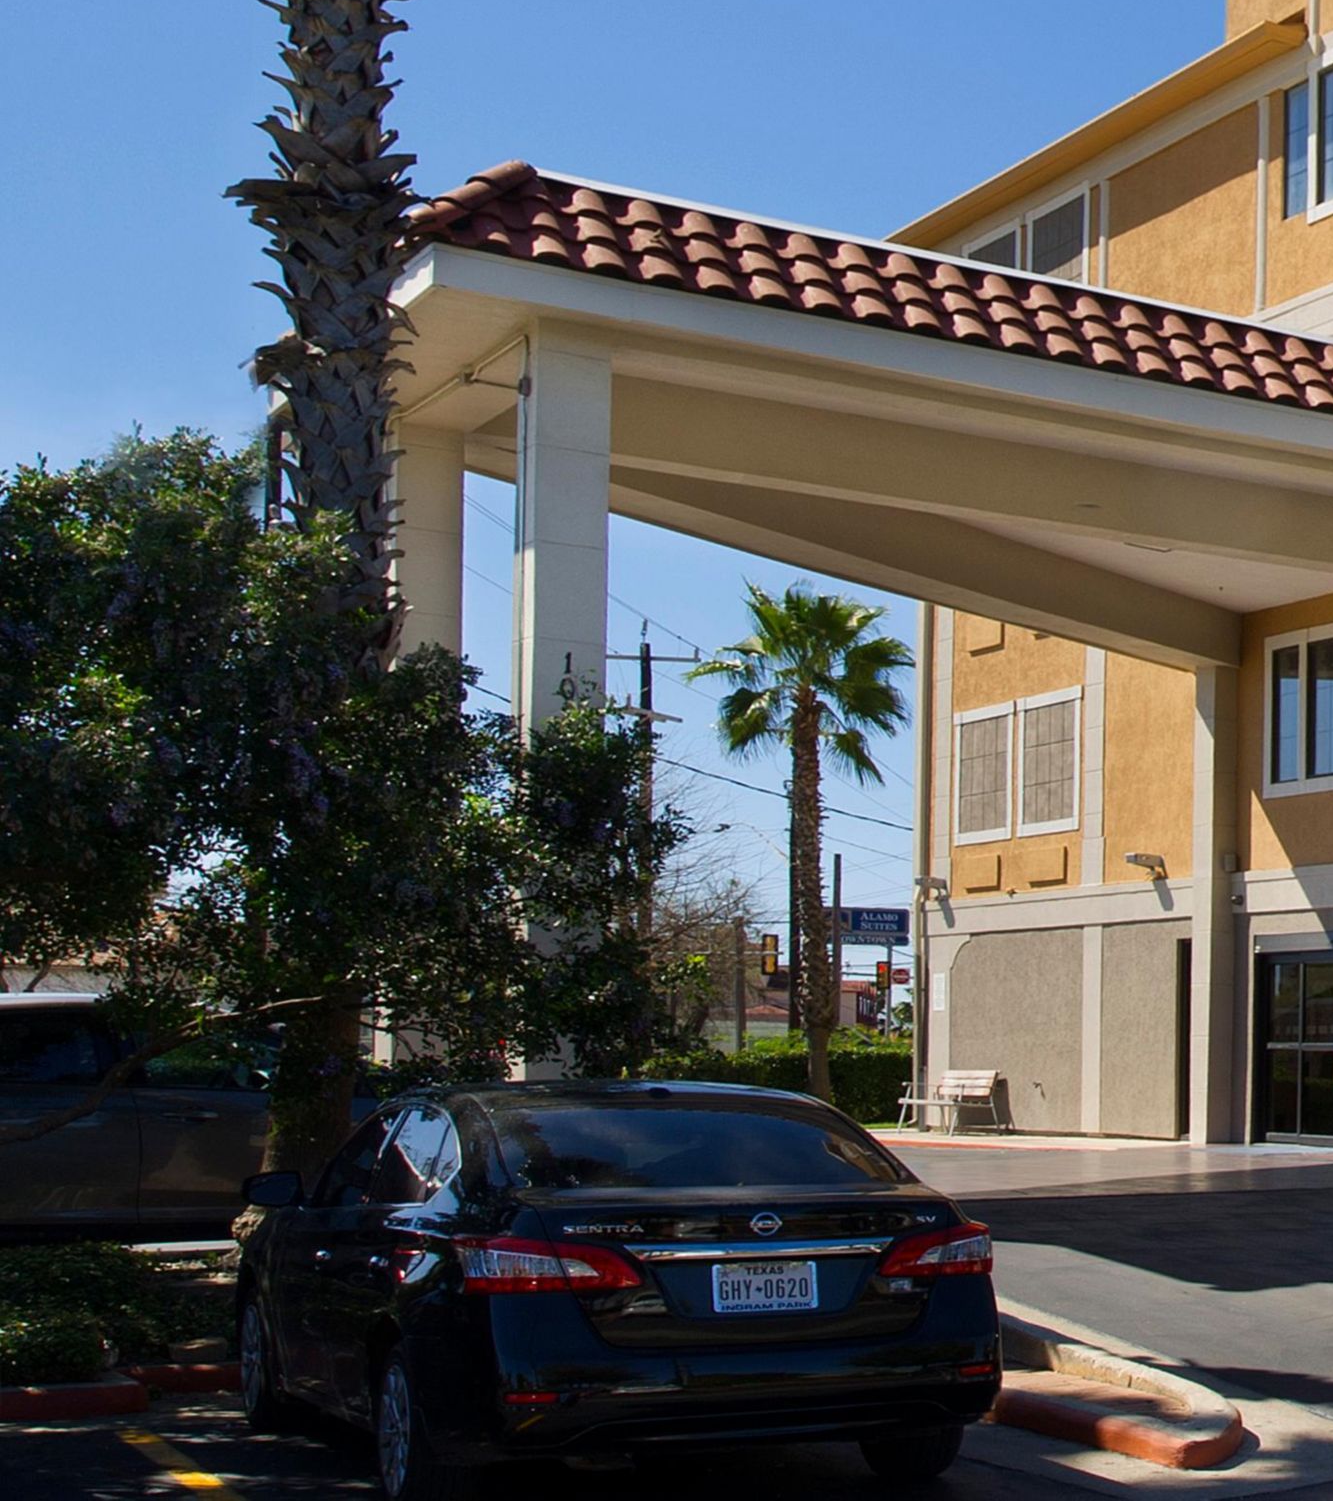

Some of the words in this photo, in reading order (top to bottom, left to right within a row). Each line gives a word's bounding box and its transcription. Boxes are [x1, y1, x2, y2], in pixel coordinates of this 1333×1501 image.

[841, 935, 896, 944] OWNTOWN
[916, 1215, 936, 1223] SV
[562, 1224, 645, 1235] SENTRA
[745, 1266, 785, 1276] TEXAS
[778, 1301, 812, 1309] PARK
